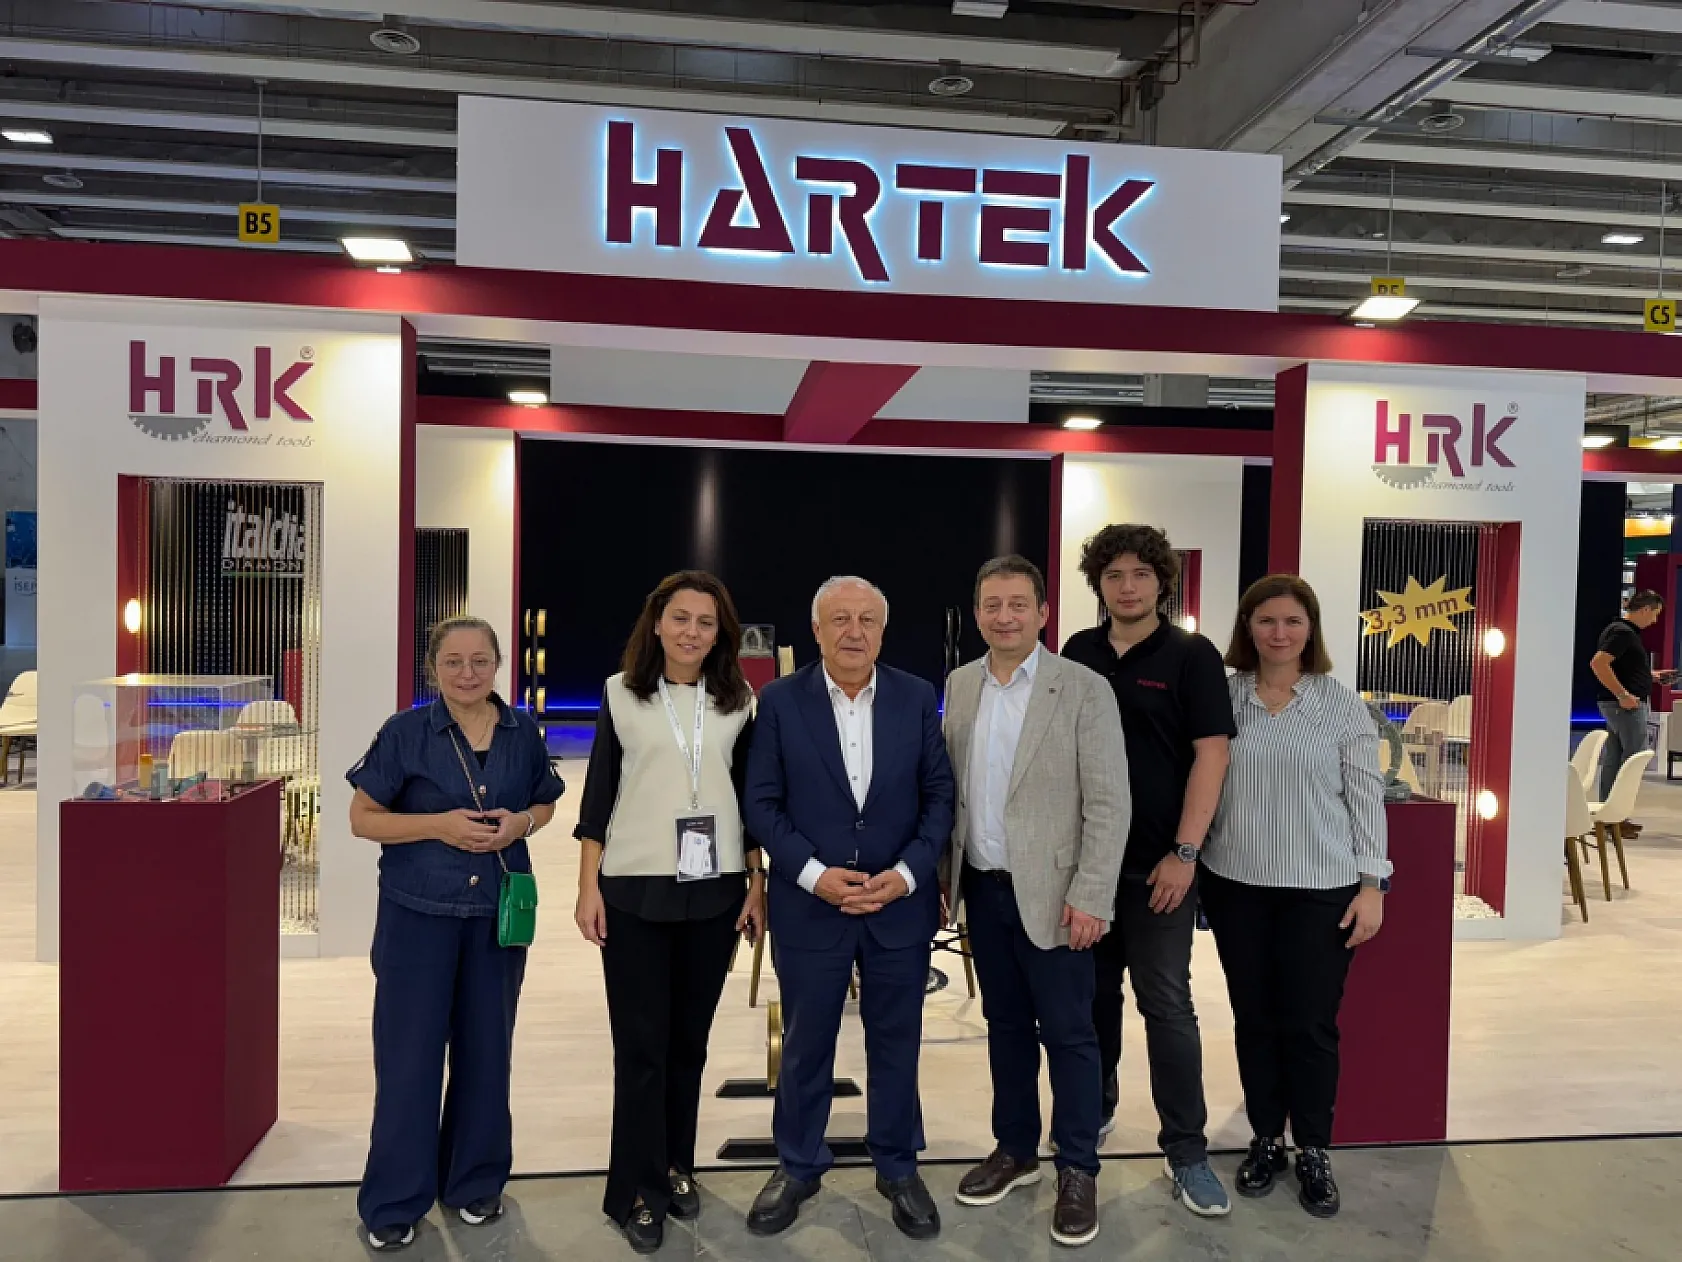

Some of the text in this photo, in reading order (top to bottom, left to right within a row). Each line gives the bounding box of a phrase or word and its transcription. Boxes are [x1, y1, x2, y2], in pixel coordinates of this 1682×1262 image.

[606, 120, 1155, 281] HARTEK
[246, 211, 271, 234] B5
[1650, 304, 1670, 324] C5
[193, 432, 315, 448] diamond tools
[1485, 481, 1516, 492] tools
[1369, 598, 1458, 633] 3,3 mm
